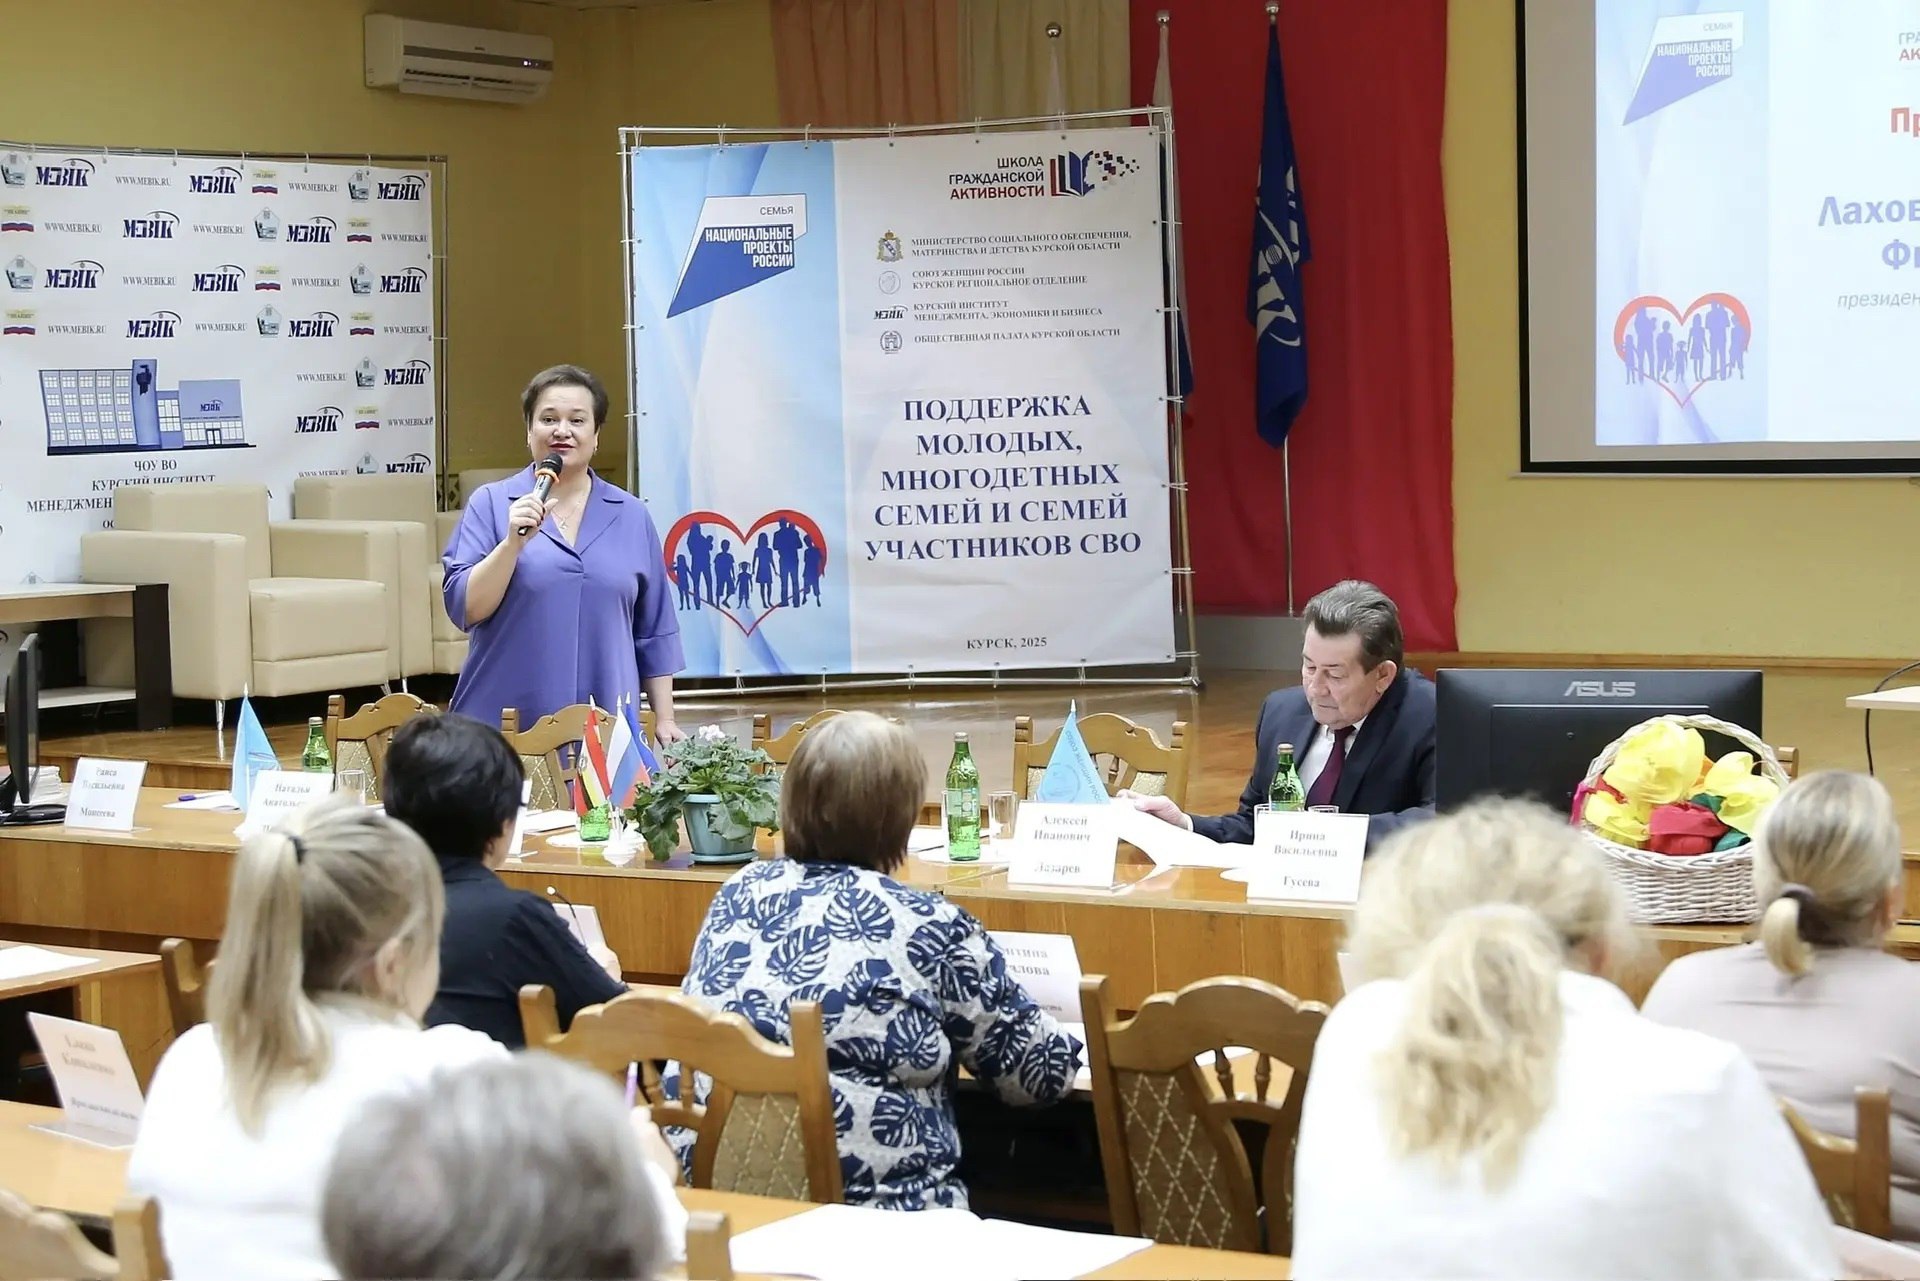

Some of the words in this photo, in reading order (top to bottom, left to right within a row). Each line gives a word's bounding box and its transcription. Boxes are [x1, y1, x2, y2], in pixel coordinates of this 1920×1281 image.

[1657, 40, 1732, 57] НАЦИОНАЛЬНЫЕ
[1688, 53, 1731, 66] ПРОЕКТЫ
[1695, 64, 1731, 77] РОССИИ
[997, 155, 1044, 170] ШКОЛА
[115, 175, 172, 186] WWW.MEBIK.RU
[949, 168, 1044, 185] ГРАЖДАНСКОЙ
[288, 182, 339, 193] WWW.MEBIK.RU
[950, 184, 1045, 200] АКТИВНОСТИ
[759, 205, 794, 216] СЕМЬЯ
[44, 222, 103, 233] WWW.MEBIK.RU
[193, 224, 244, 235] WWW.MEBIK.RU
[705, 226, 793, 243] НАЦИОНАЛЬНЫЕ
[911, 236, 987, 246] МИНИСТЕРСТВО
[988, 234, 1058, 244] СОЦИАЛЬНОГО
[1060, 231, 1131, 240] ОБЕСПЕЧЕНИЯ,
[743, 240, 793, 255] ПРОЕКТЫ
[912, 247, 978, 257] МАТЕРИНСТВА
[980, 246, 987, 254] И
[989, 245, 1029, 255] ДЕТСТВА
[1032, 243, 1075, 253] КУРСКОЙ
[1077, 242, 1121, 251] ОБЛАСТИ
[753, 253, 794, 268] РОССИИ
[912, 270, 939, 279] СОЮЗ
[941, 268, 985, 277] ЖЕНЩИН
[987, 267, 1025, 276] РОССИИ
[123, 276, 176, 286] WWW.MEBIK.RU
[291, 277, 340, 287] WWW.MEBIK.RU
[913, 281, 955, 290] КУРСКОЕ
[957, 278, 1031, 288] РЕГИОНАЛЬНОЕ
[1032, 275, 1087, 285] ОТДЕЛЕНИЕ
[914, 301, 956, 310] КУРСКИЙ
[959, 300, 1009, 309] ИНСТИТУТ
[914, 312, 988, 321] МЕНЕДЖМЕНТА,
[990, 309, 1050, 319] ЭКОНОМИКИ
[1052, 309, 1059, 317] И
[1061, 308, 1103, 316] БИЗНЕСА
[48, 325, 106, 335] WWW.MEBIK.RU
[195, 323, 247, 333] WWW.MEBIK.RU
[915, 333, 990, 343] ОБЩЕСТВЕННАЯ
[993, 331, 1029, 341] ПАЛАТА
[1032, 329, 1075, 339] КУРСКОЙ
[1077, 328, 1121, 337] ОБЛАСТИ
[904, 394, 1091, 424] ПОДДЕРЖКА
[916, 430, 1082, 456] МОЛОДЫХ,
[134, 460, 158, 472] ЧОУ
[161, 459, 177, 471] ВО
[881, 463, 1120, 491] МНОГОДЕТНЫХ
[27, 497, 112, 513] МЕНЕДЖМЕН
[874, 497, 981, 527] СЕМЕЙ
[991, 502, 1010, 523] И
[1020, 493, 1128, 522] СЕМЕЙ
[864, 534, 1071, 561] УЧАСТНИКОВ
[1080, 531, 1141, 554] СВО
[966, 638, 1017, 649] КУРСК,
[1020, 637, 1047, 648] 2025
[1564, 681, 1636, 697] ASUS
[1041, 814, 1088, 825] Алексей
[1034, 829, 1091, 841] Иванович
[1290, 829, 1326, 842] Ирина
[1274, 844, 1338, 857] Васильевна
[1034, 861, 1081, 876] Лазарев
[1283, 875, 1321, 888] Гусева
